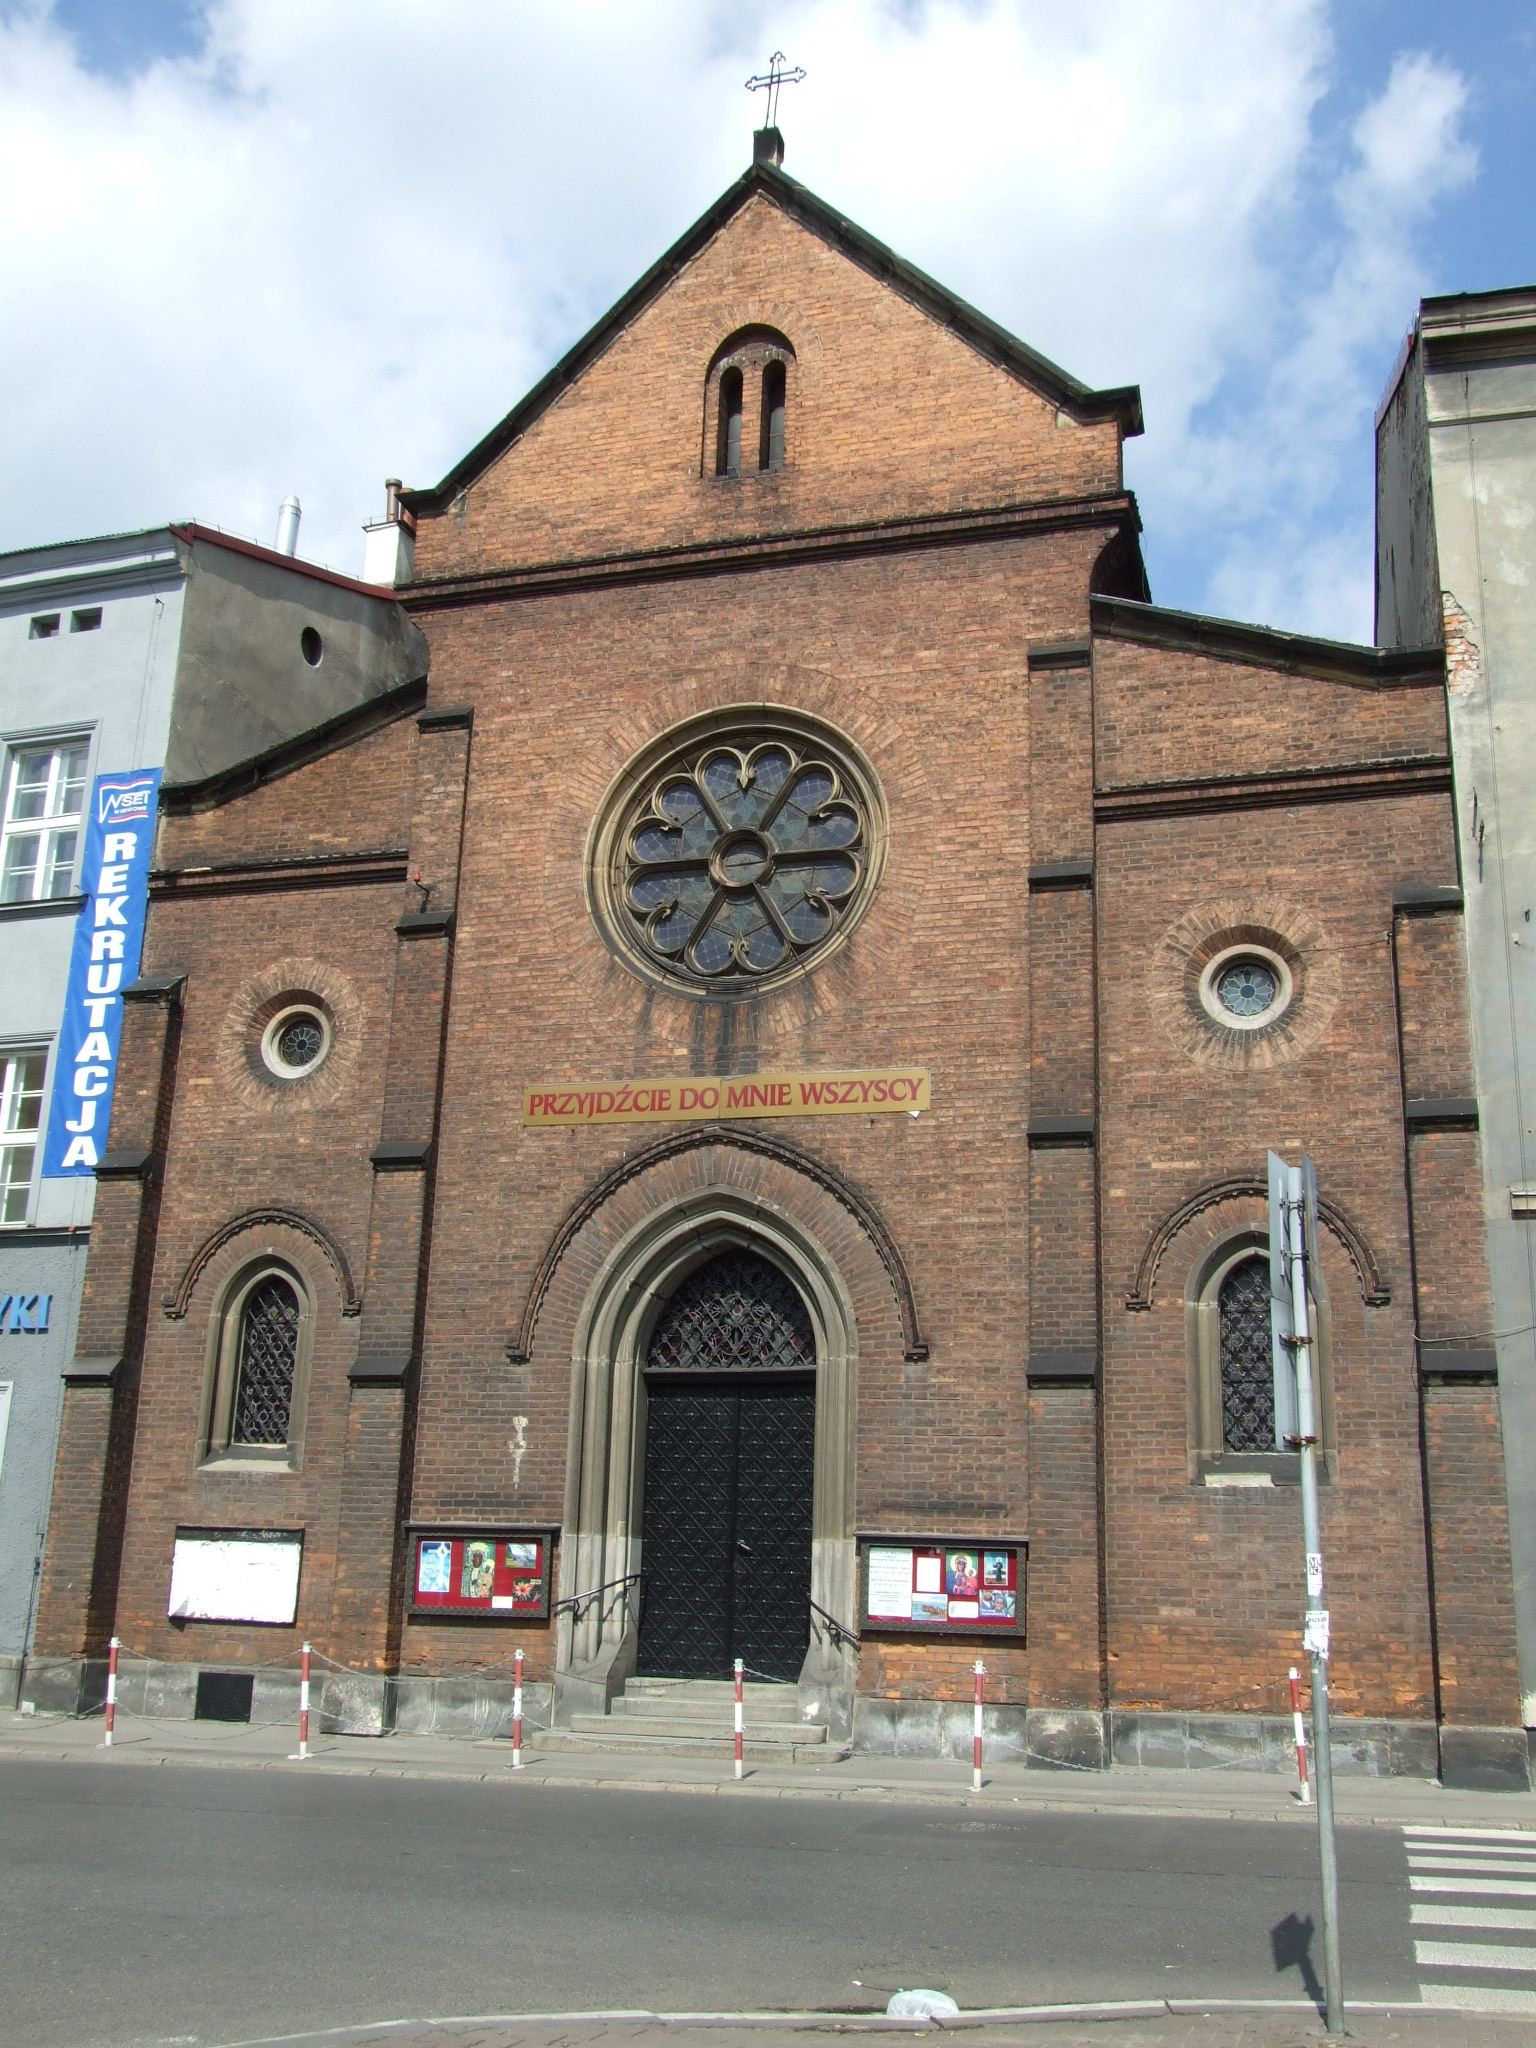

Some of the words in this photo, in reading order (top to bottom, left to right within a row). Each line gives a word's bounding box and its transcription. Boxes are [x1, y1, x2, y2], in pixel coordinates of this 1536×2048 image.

[61, 832, 138, 1168] REKRUTACJA
[528, 1083, 672, 1118] PRZYJDŹCIE
[678, 1087, 720, 1111] DO
[725, 1083, 793, 1108] MNIE
[799, 1078, 924, 1105] WSZYSCY
